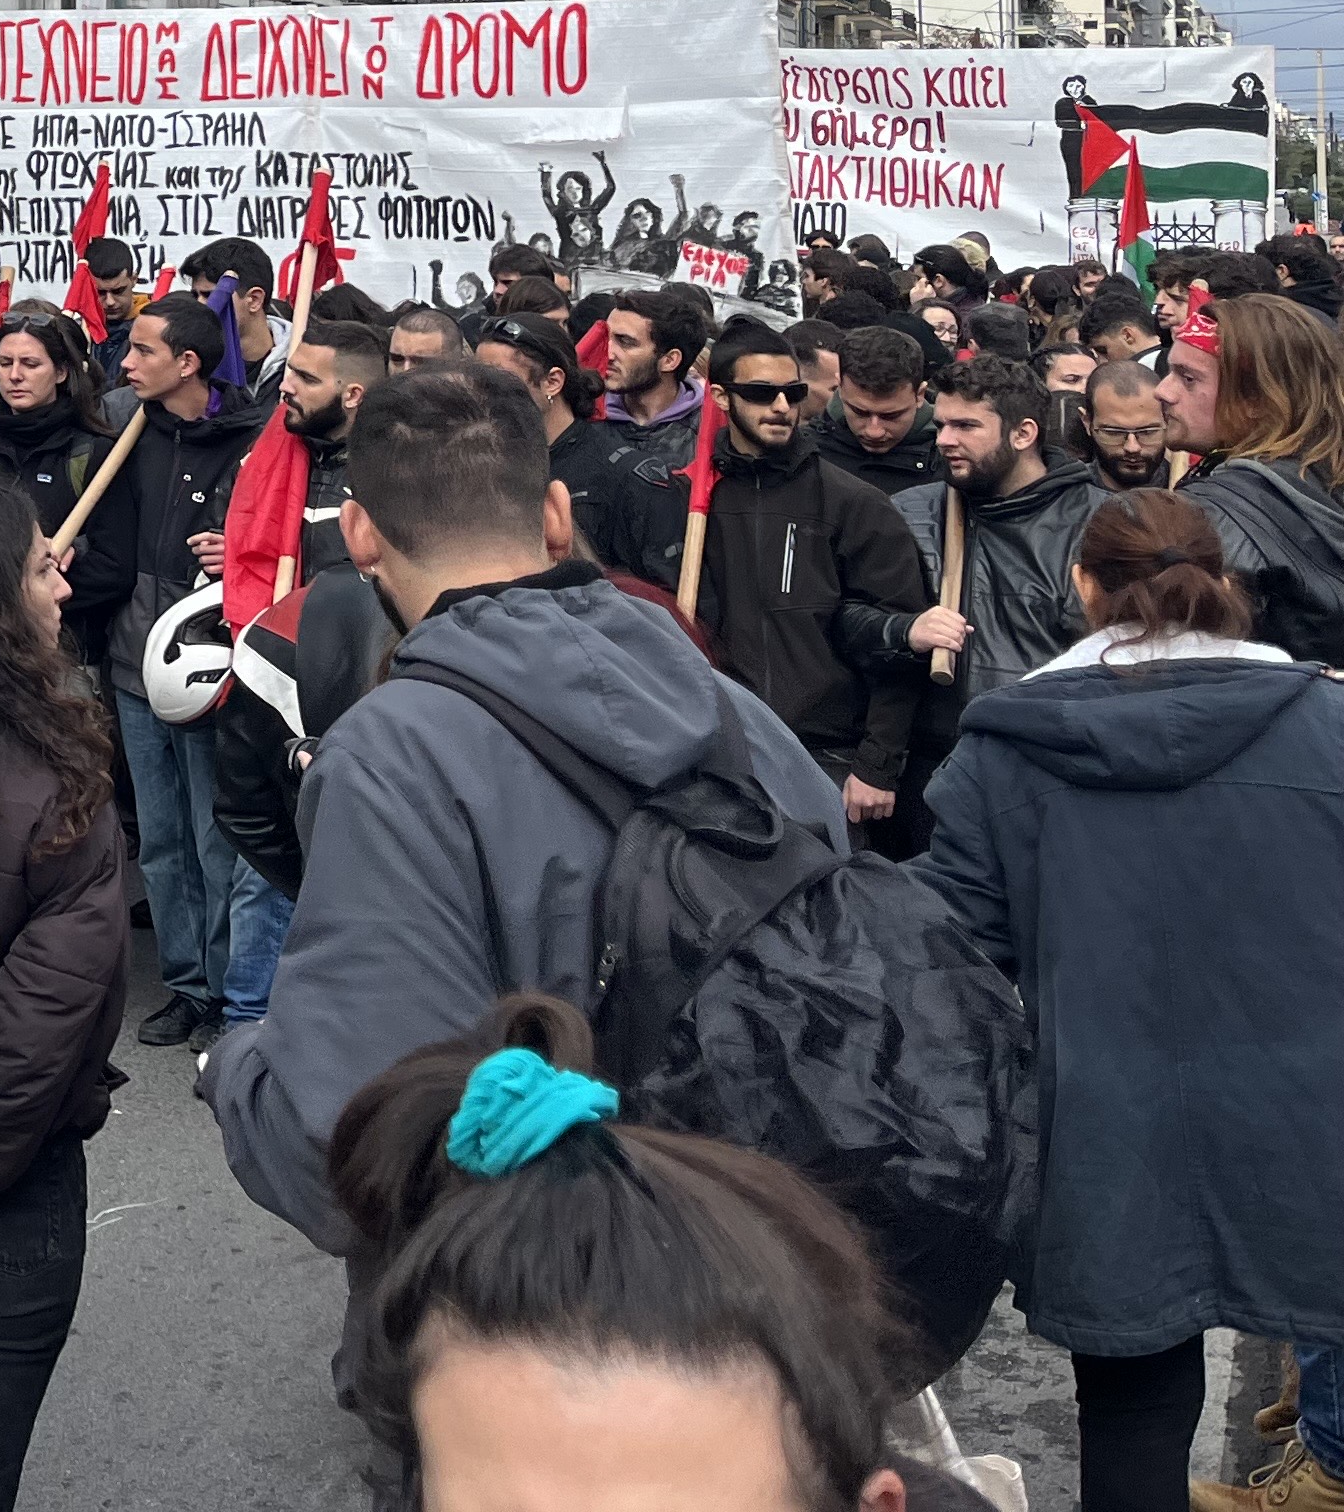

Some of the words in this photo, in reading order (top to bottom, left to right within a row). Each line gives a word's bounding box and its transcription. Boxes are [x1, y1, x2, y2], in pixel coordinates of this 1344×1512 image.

[199, 13, 350, 102] ΔΕΙΧΝΕΙ
[416, 2, 589, 101] ΔΡΟΜΟ
[165, 165, 200, 189] και
[205, 164, 247, 201] της
[156, 193, 222, 237] ΣΤΙΣ
[237, 194, 372, 240] ΔΙΑΓΡΕΣ
[378, 191, 496, 242] ΦΟΙΤΗΤΩΝ
